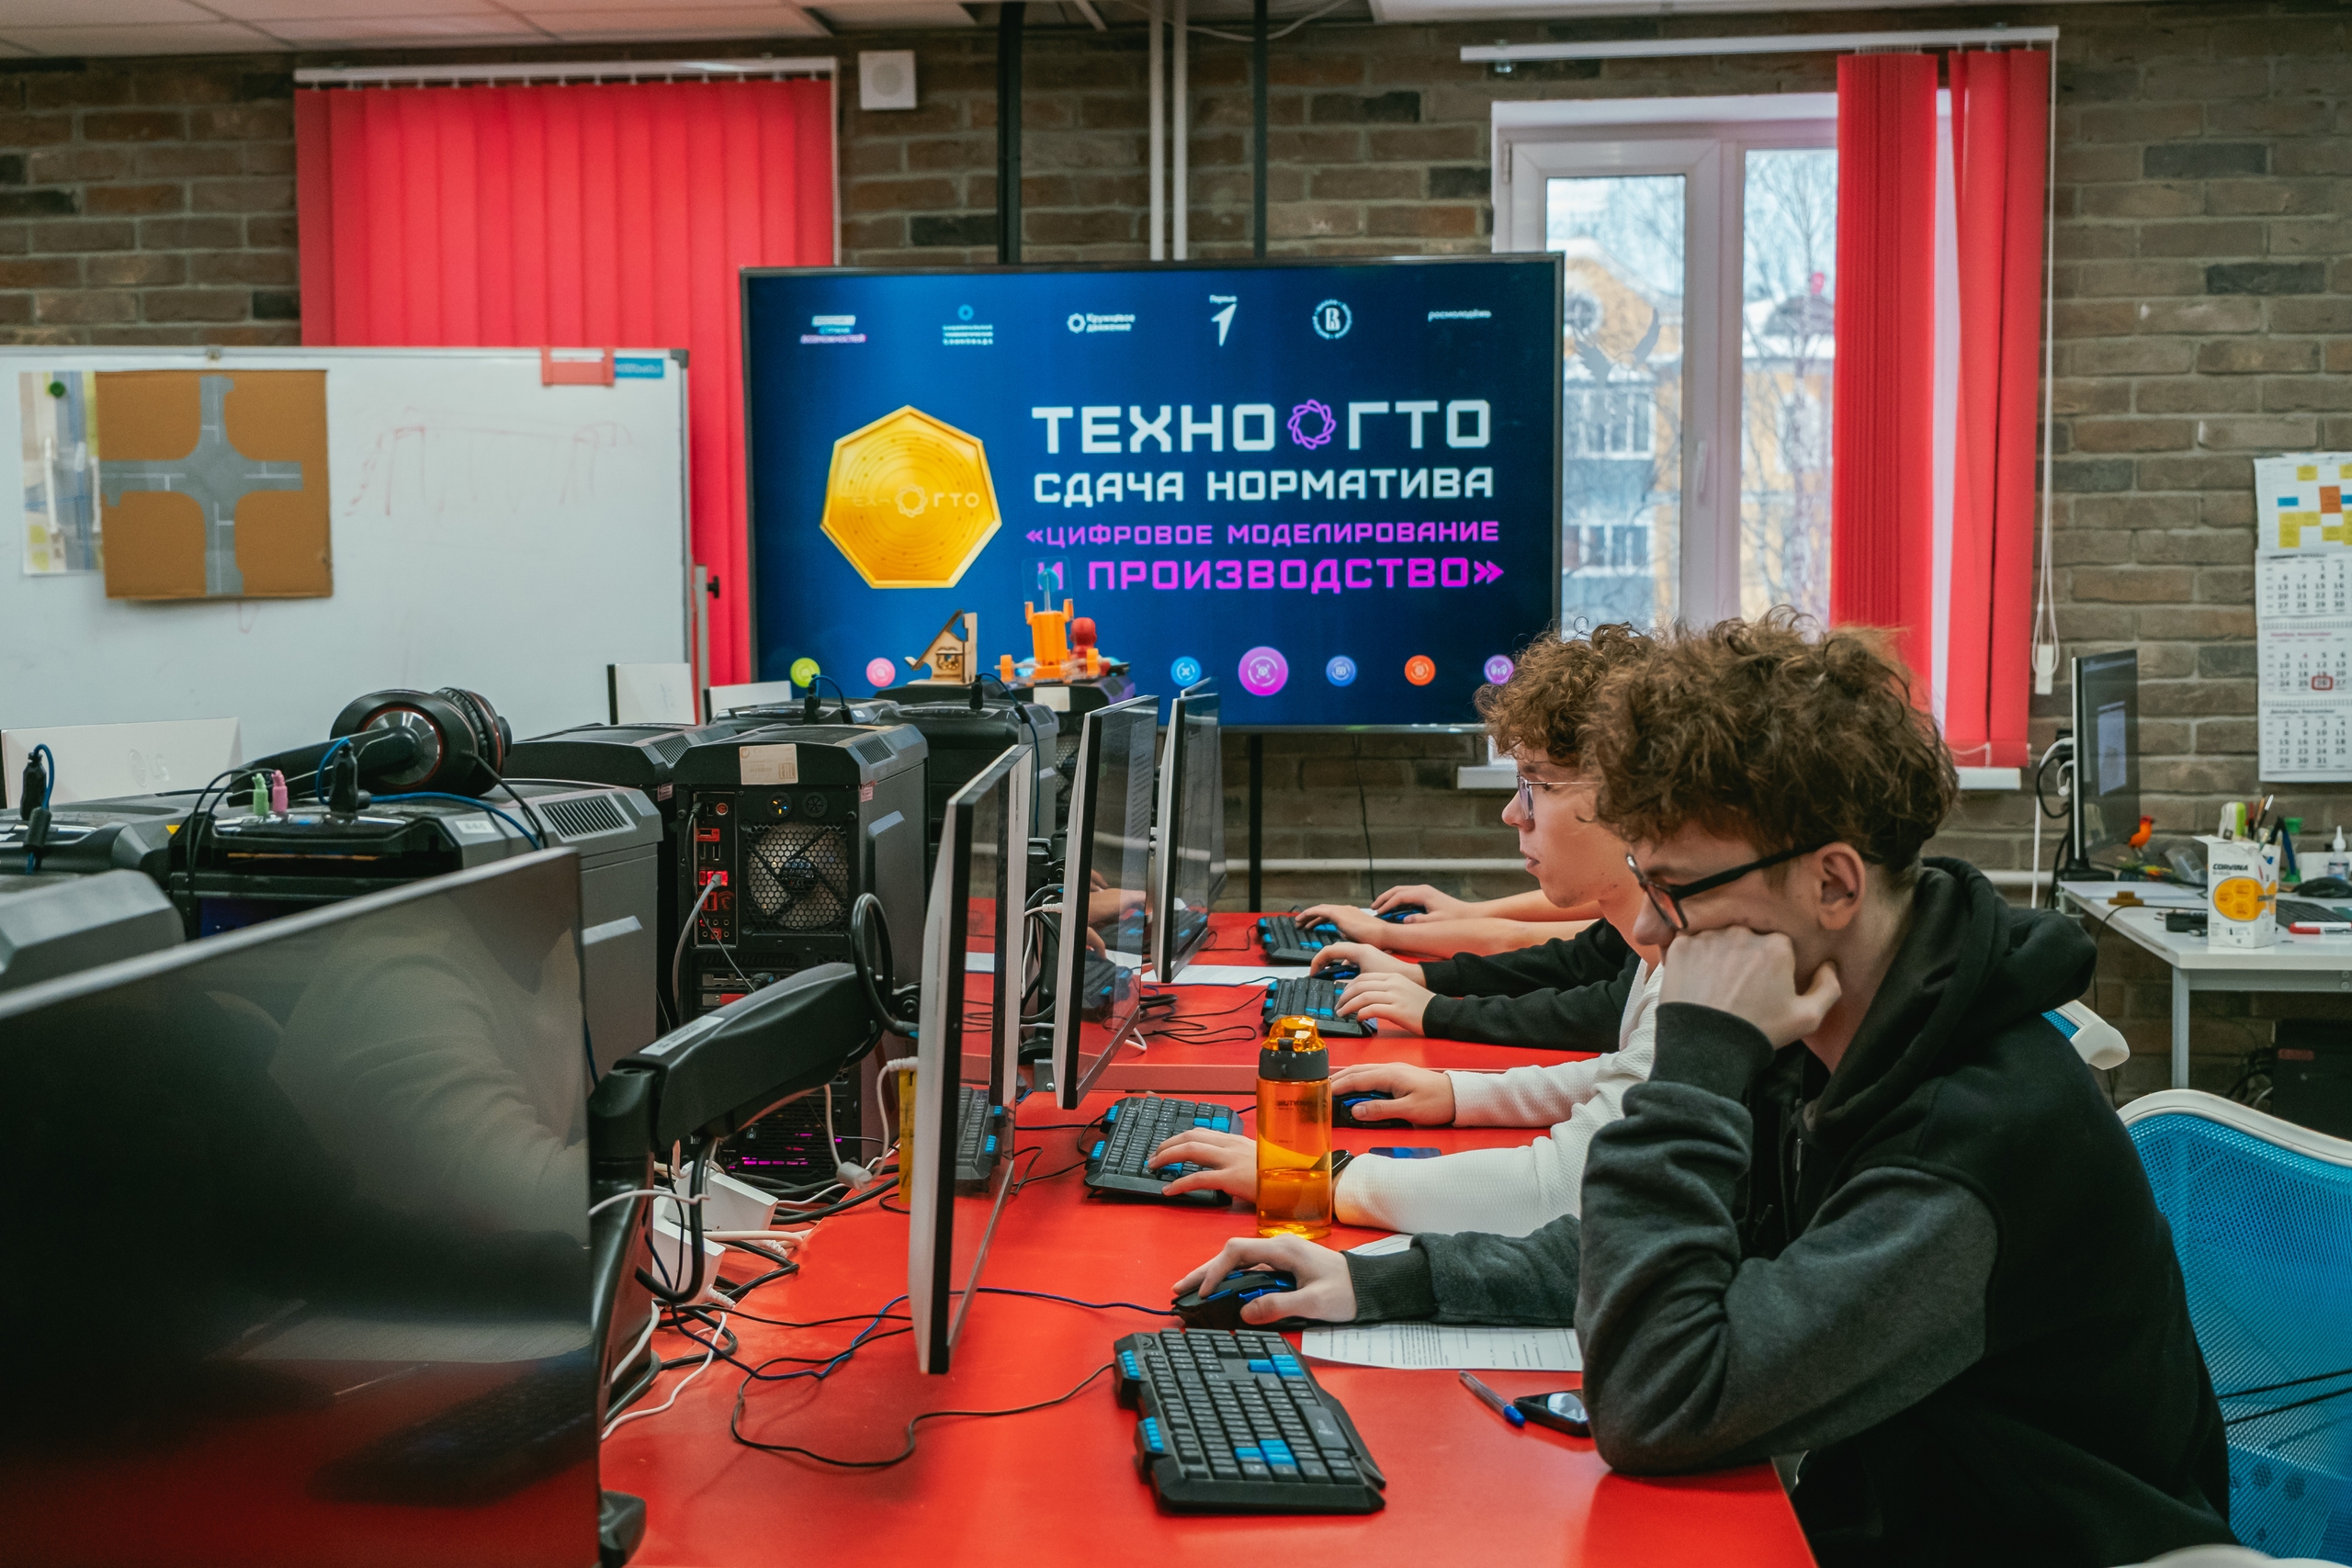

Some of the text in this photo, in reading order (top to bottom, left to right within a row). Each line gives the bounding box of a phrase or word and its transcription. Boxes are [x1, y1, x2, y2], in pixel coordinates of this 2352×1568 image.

[1031, 400, 1490, 454] ТЕХНО ГТО
[933, 491, 980, 508] ГТО
[1035, 467, 1493, 508] СДАЧА НОРМАТИВА
[1025, 521, 1499, 548] «ЦИФРОВОЕ МОДЕЛИРОВАНИЕ
[1088, 557, 1504, 594] ПРОИЗВОДСТВО»
